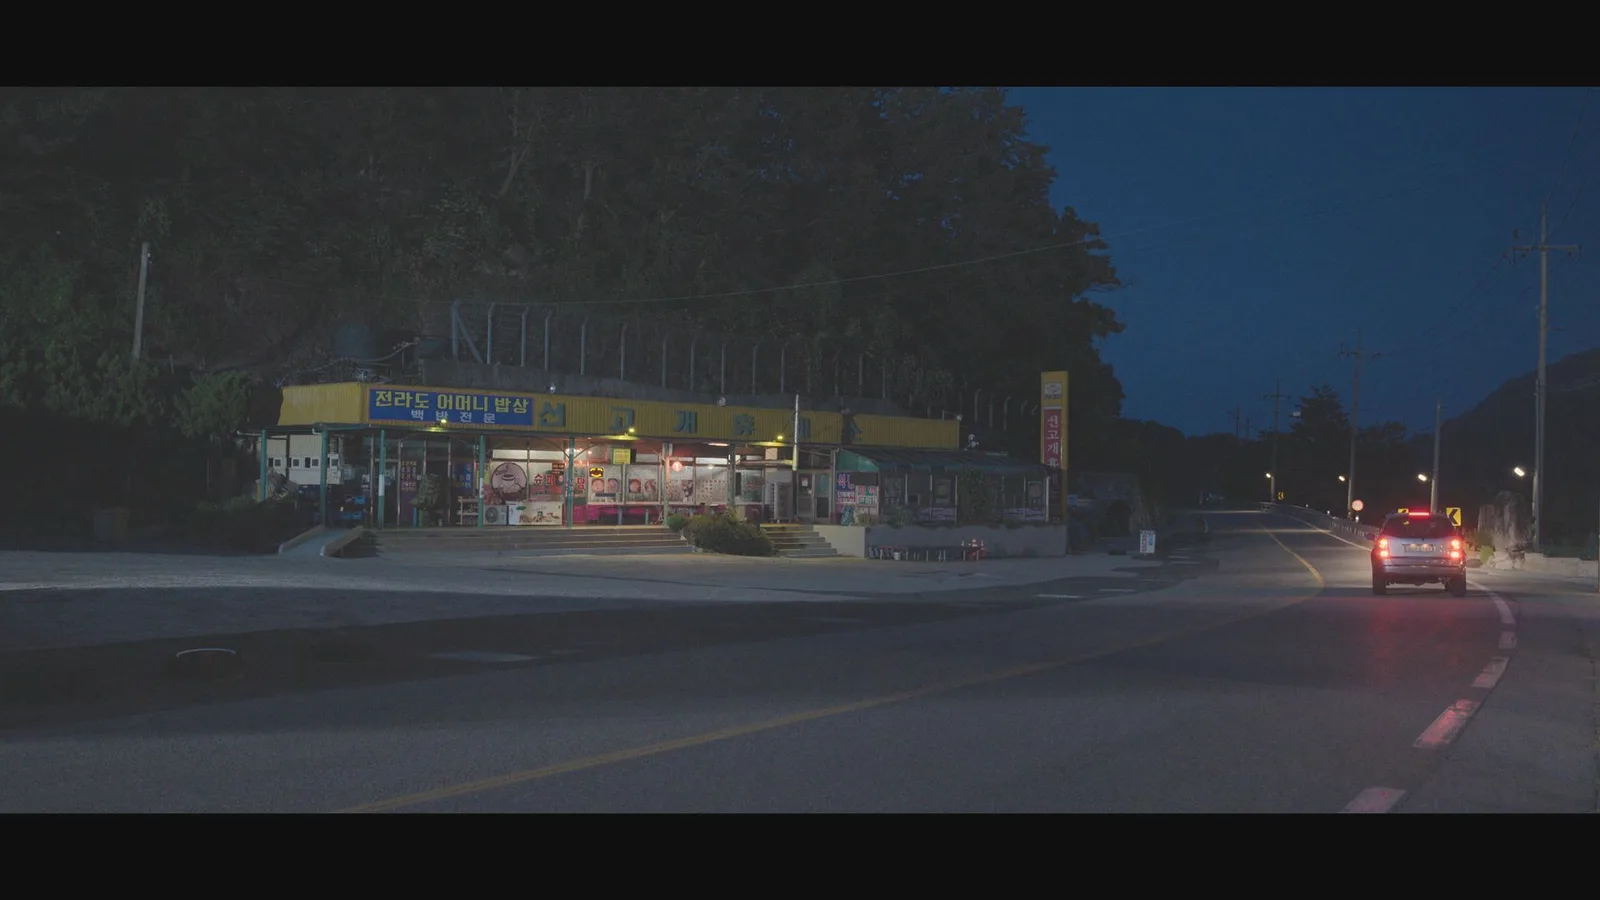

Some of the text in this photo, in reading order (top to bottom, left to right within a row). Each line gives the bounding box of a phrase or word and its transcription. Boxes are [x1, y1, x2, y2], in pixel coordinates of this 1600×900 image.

[374, 390, 529, 414] 전라도 어머니 밥상
